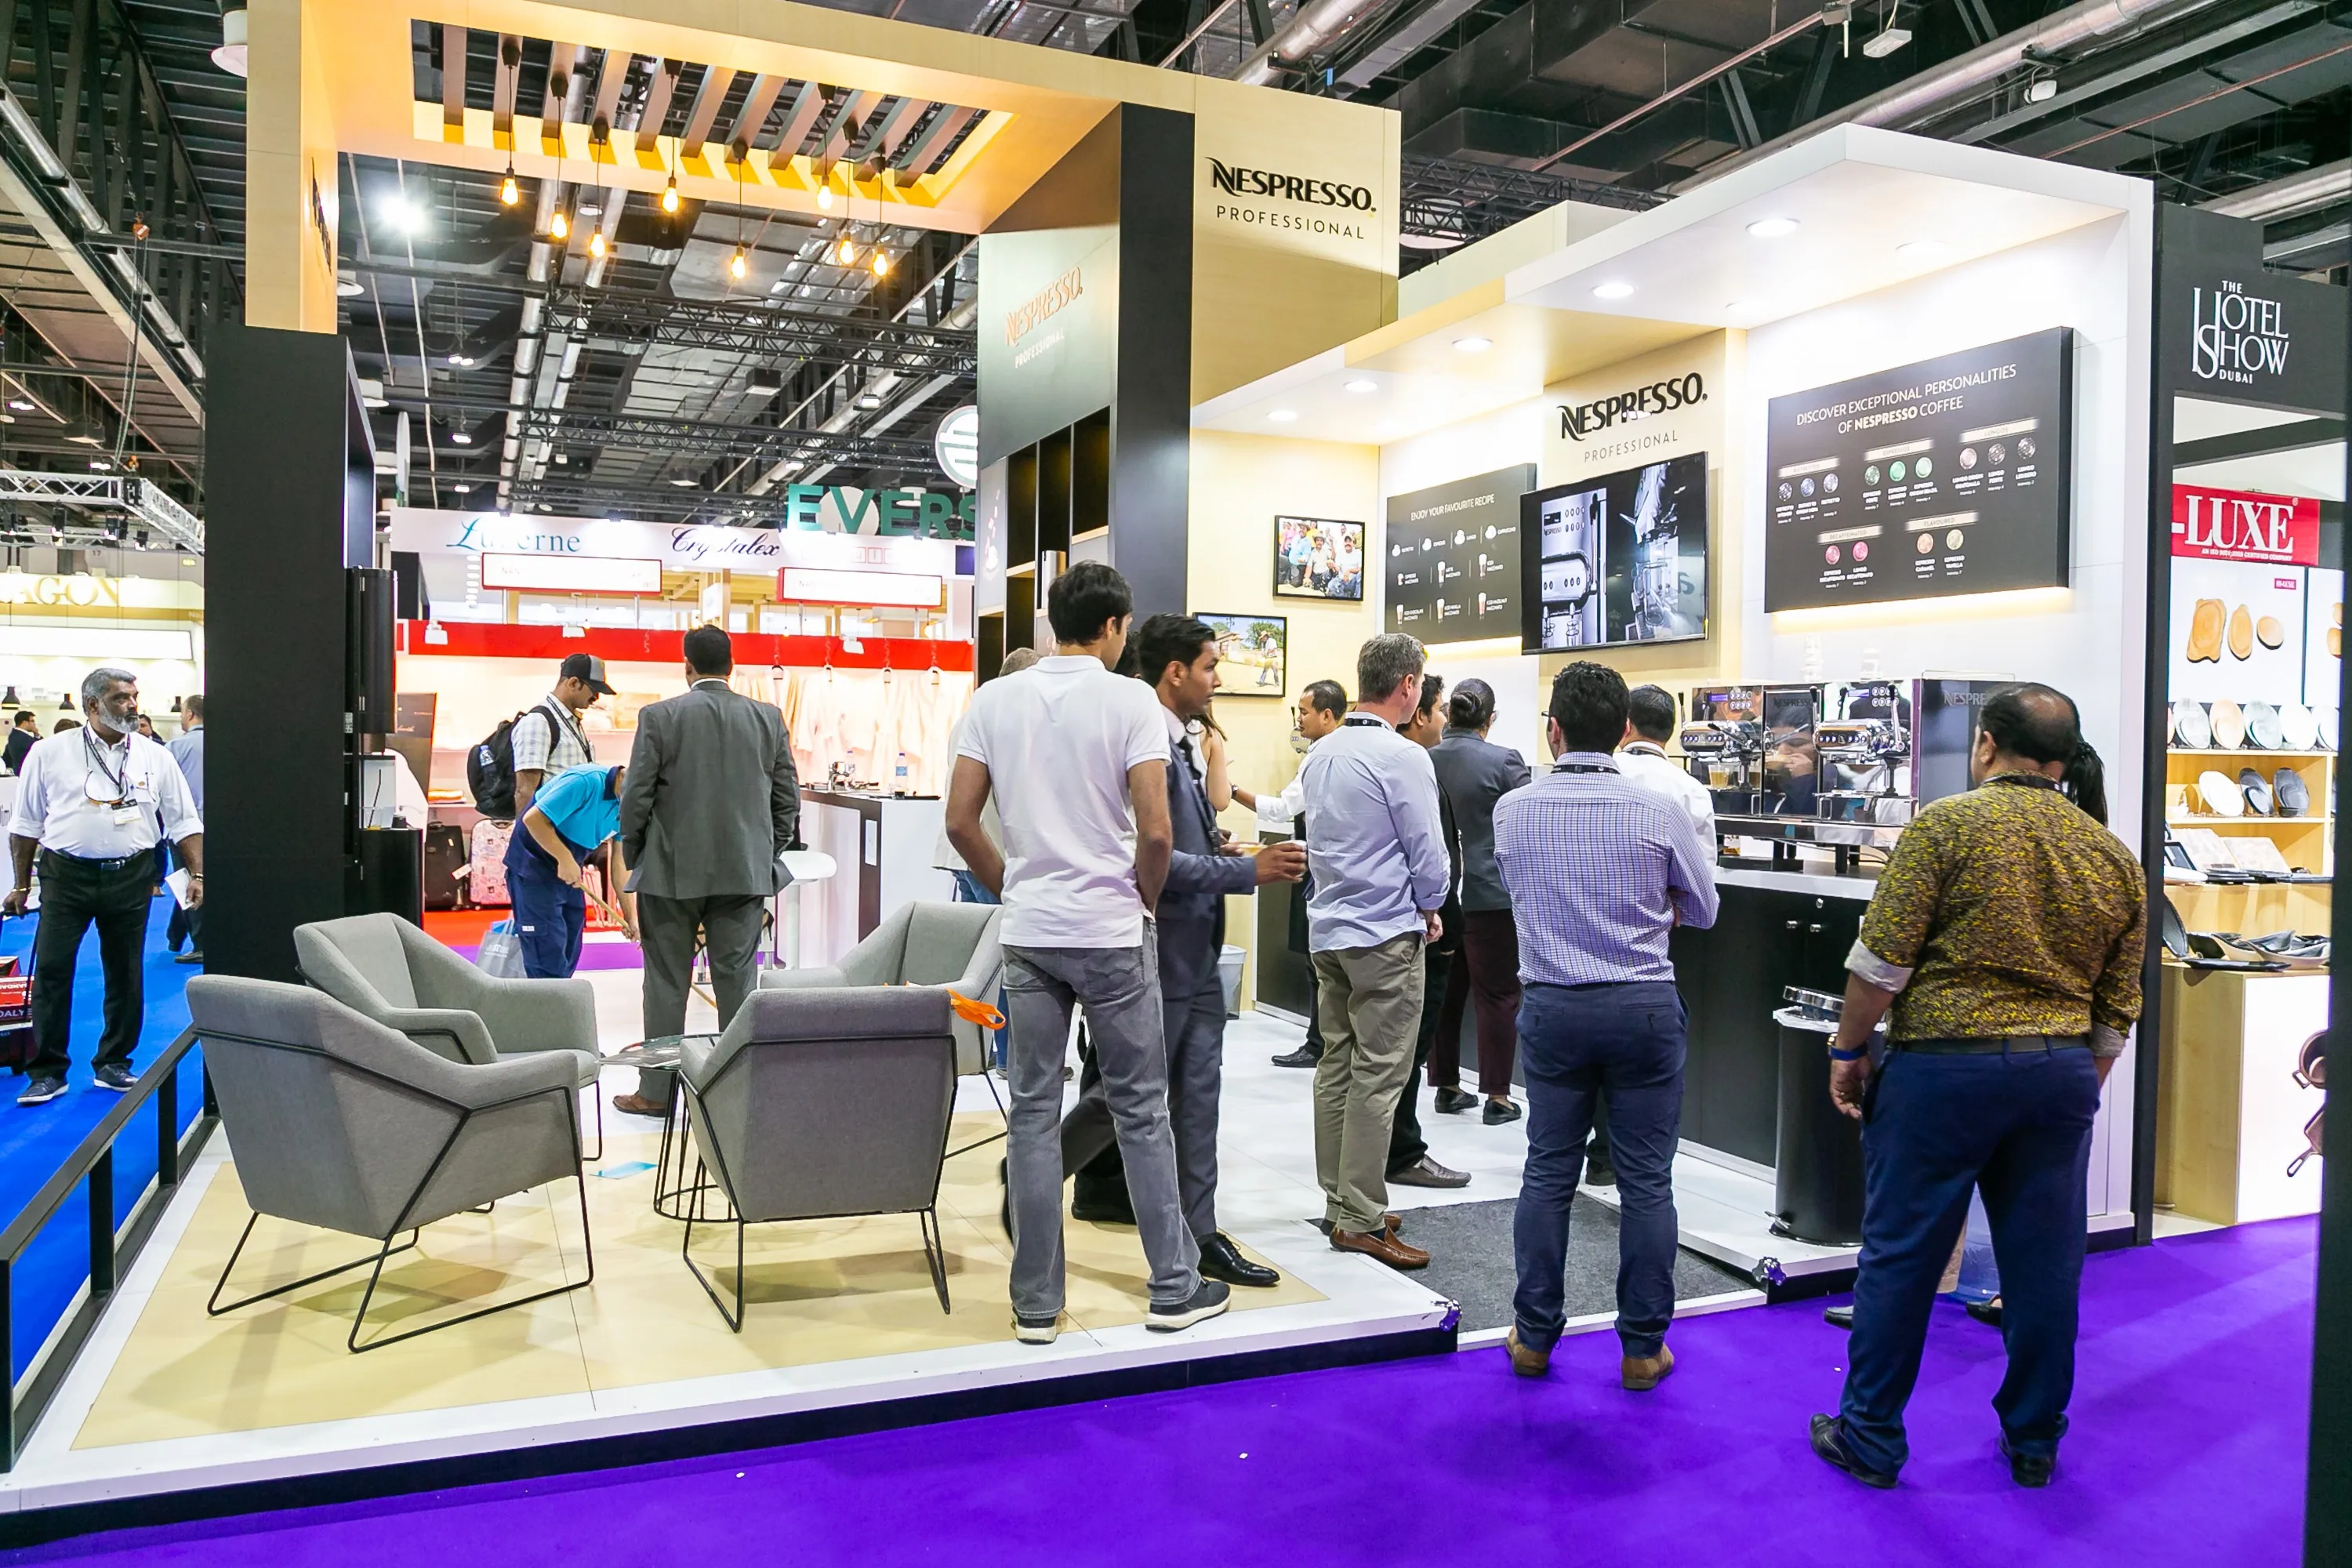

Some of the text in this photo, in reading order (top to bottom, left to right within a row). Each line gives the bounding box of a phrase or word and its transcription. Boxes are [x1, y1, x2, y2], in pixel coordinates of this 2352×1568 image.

[1205, 157, 1373, 210] NESPRESSO
[1216, 205, 1364, 239] PROFESSIONAL
[2221, 280, 2243, 294] THE
[1005, 266, 1081, 347] NESPRESSO
[2192, 287, 2289, 372] HOTEL
[2198, 324, 2289, 379] SHOW
[1796, 363, 2017, 426] DISCOVER EXCEPTIONAL PERSONALITIES
[2219, 369, 2253, 384] DUBAI
[1556, 372, 1704, 441] NESPRESSO
[1838, 395, 1964, 434] OF NESPRESSO COFFEE
[1584, 430, 1679, 463] PROFESSIONAL
[1410, 493, 1495, 521] ENJOY YOUR FAVOURITE RECIPE
[671, 527, 781, 561] Crytalex
[1943, 689, 1987, 706] NESPRE
